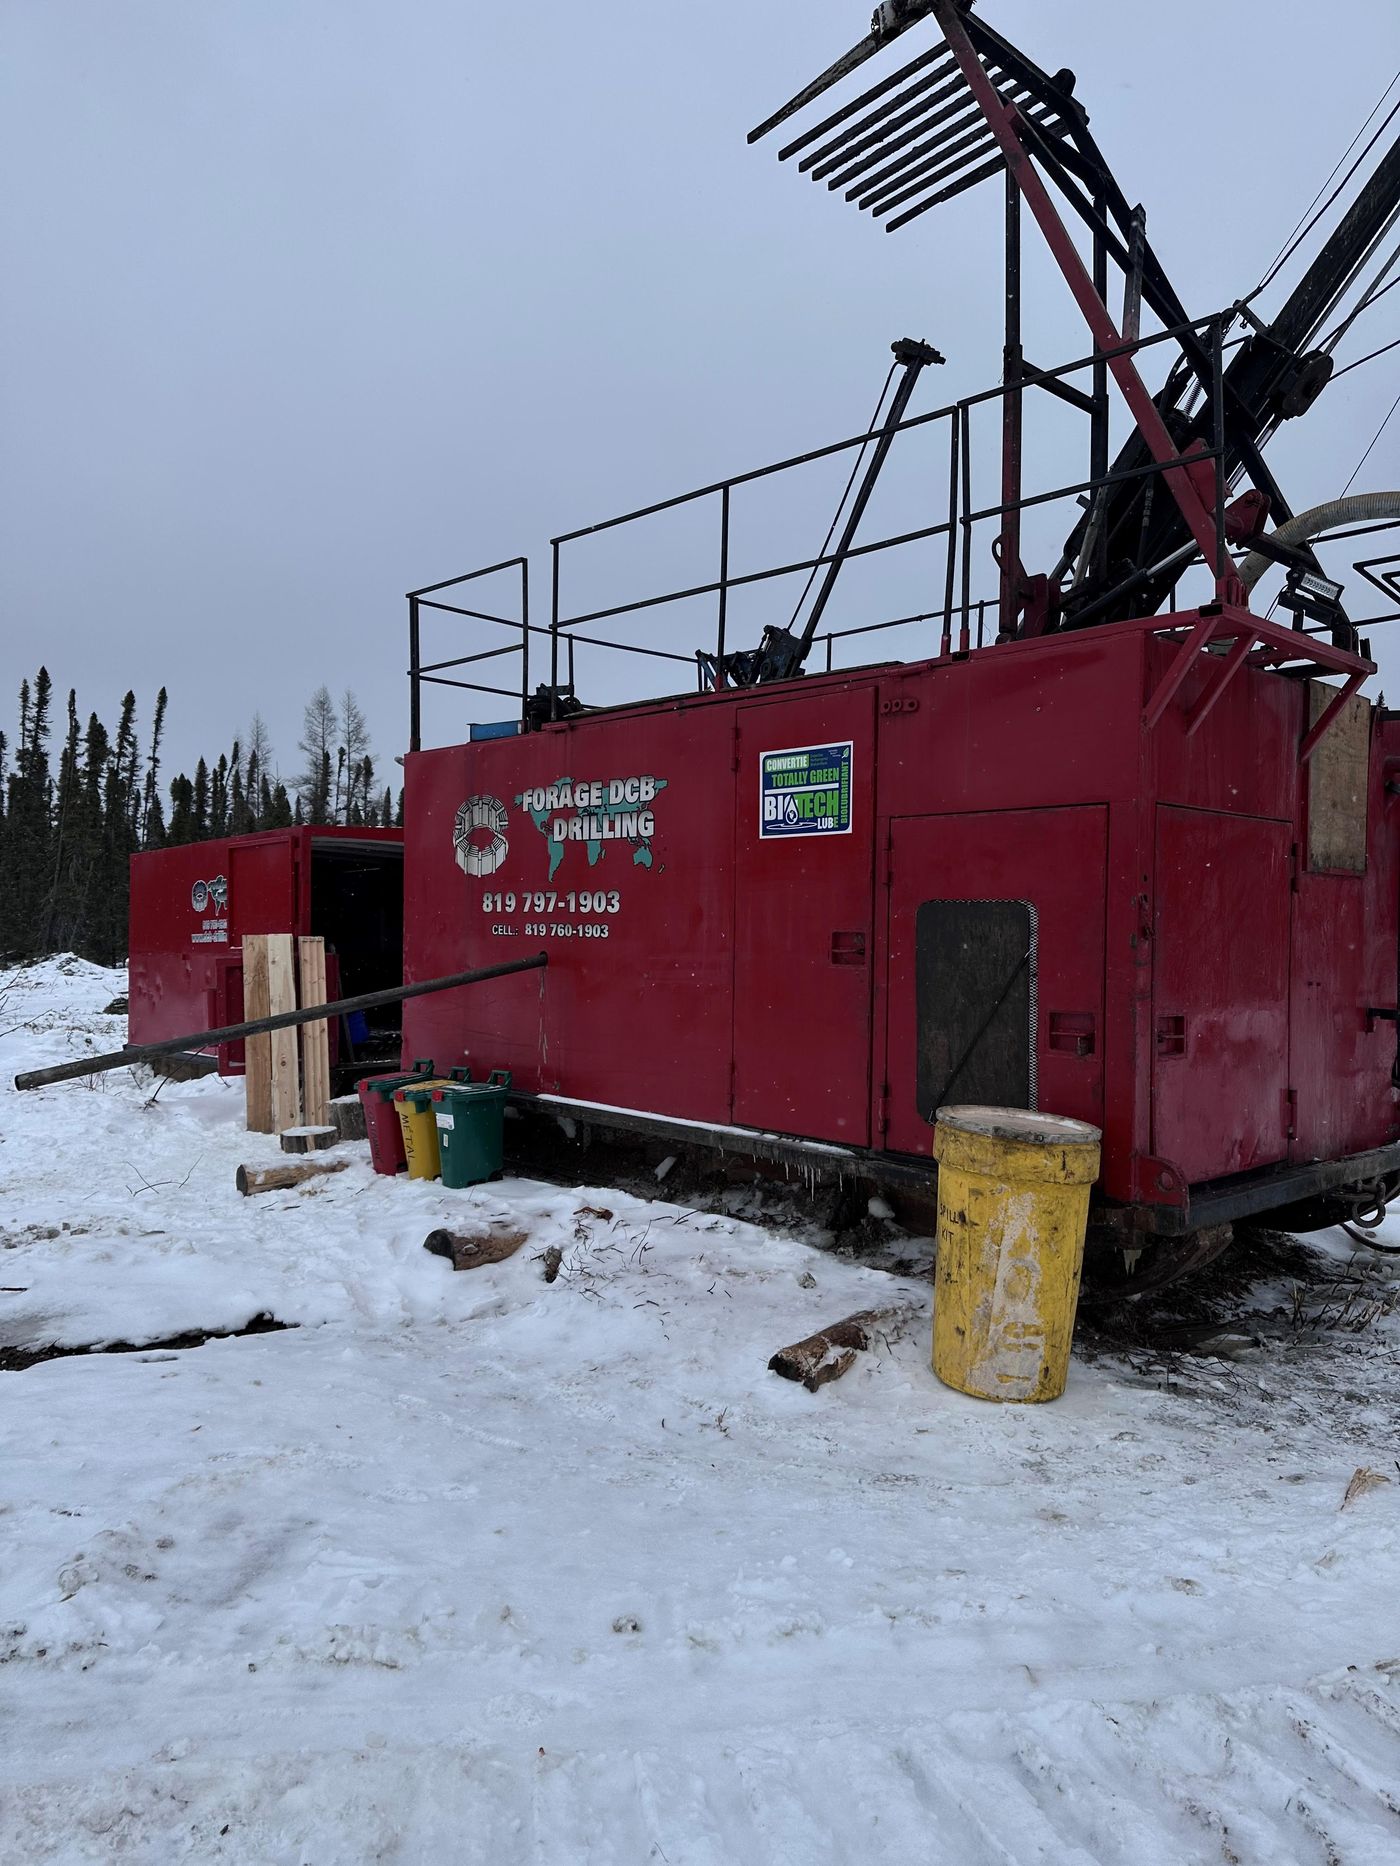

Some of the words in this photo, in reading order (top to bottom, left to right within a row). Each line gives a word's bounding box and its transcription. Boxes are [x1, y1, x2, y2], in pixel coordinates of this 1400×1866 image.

[766, 756, 808, 771] CONVERTIE
[772, 771, 808, 787] TOTALLY
[810, 768, 839, 784] GREEN
[522, 781, 603, 812] FORAGE
[609, 776, 655, 804] DCB
[841, 761, 849, 824] BIOLUBRIFIANT
[553, 811, 655, 842] DRILLING
[817, 817, 839, 829] LUBE
[482, 892, 516, 913] 819
[522, 891, 621, 914] 797-1903
[525, 924, 546, 936] 819
[550, 924, 609, 938] 760-1903
